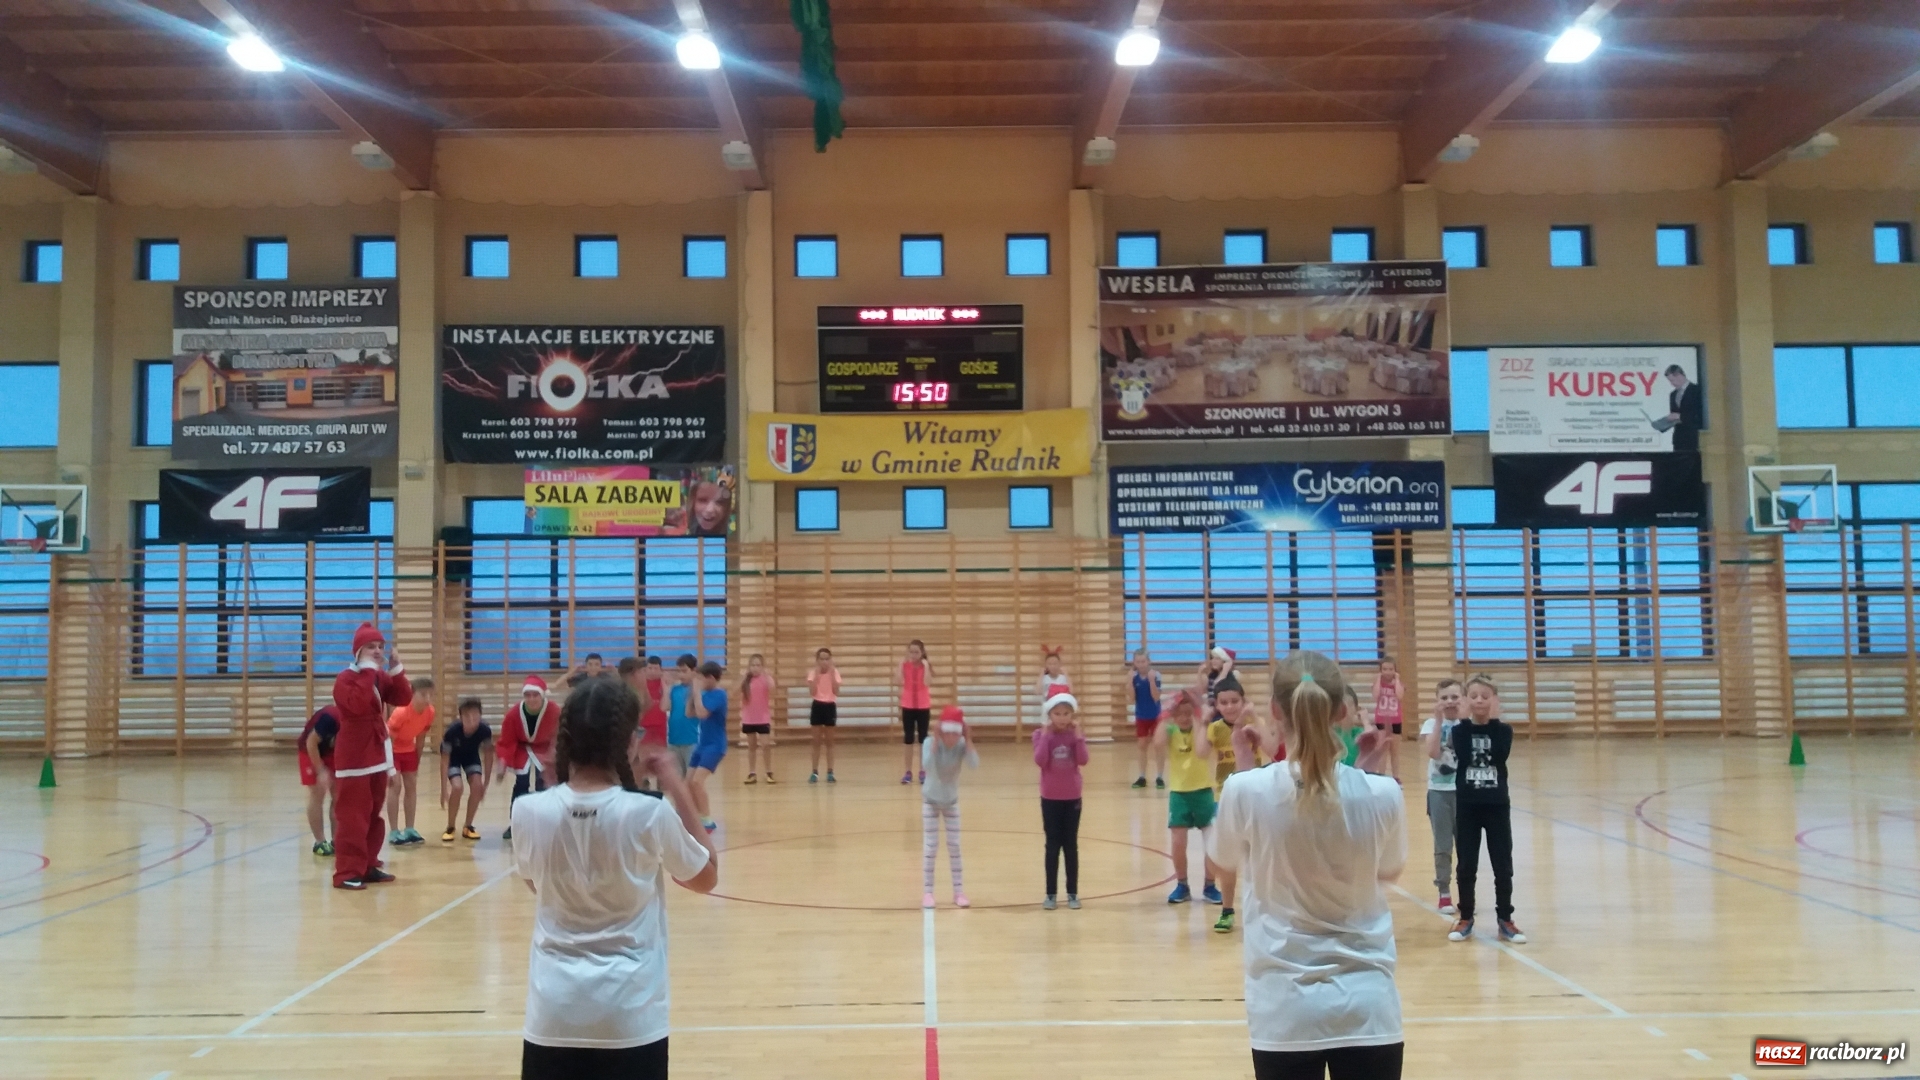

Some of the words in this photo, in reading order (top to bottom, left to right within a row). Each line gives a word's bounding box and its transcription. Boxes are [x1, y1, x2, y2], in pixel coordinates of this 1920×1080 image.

[1382, 268, 1432, 277] CATERING
[1107, 275, 1196, 294] WESELA
[1204, 284, 1264, 292] SPOTKANIA
[1404, 278, 1442, 287] OGRÓD
[183, 290, 286, 309] SPONSOR
[291, 288, 387, 307] IMPREZY
[208, 315, 240, 325] Janik
[243, 315, 288, 326] Marcin,
[290, 313, 362, 326] Błażejowice
[892, 307, 947, 321] RUDNIK
[453, 329, 572, 344] INSTALACJE
[579, 329, 715, 344] ELEKTRYCZNE
[827, 362, 899, 376] GOSPODARZE
[959, 358, 998, 375] GOŚCIE
[1500, 358, 1534, 372] ZDZ
[507, 357, 671, 411] FIOŁKA
[1548, 371, 1659, 397] KURSY
[893, 383, 949, 402] 15:50
[1204, 407, 1286, 421] SZONOWICE
[1309, 406, 1329, 418] UL.
[1333, 405, 1389, 417] WYGON
[1393, 404, 1402, 416] 3
[510, 418, 531, 426] 603
[557, 418, 577, 426] 977
[639, 418, 660, 426] 603
[662, 418, 683, 426] 798
[686, 417, 706, 426] 967
[1250, 425, 1265, 434] tel.
[1288, 424, 1300, 433] 32
[1338, 423, 1350, 432] 30
[1367, 422, 1384, 431] +48
[258, 425, 313, 437] MERCEDES,
[316, 424, 347, 435] GRUPA
[371, 423, 388, 434] VW
[510, 430, 531, 439] 605
[533, 430, 554, 439] 083
[640, 430, 661, 439] 607
[664, 430, 684, 439] 336
[903, 420, 1002, 447] Witamy
[222, 441, 247, 455] tel.
[250, 442, 270, 454] 77
[272, 441, 300, 454] 487
[304, 441, 322, 454] 57
[326, 440, 346, 453] 63
[515, 446, 654, 461] www.fiolka.com.pl
[840, 458, 862, 474] w
[871, 450, 962, 474] Gminie
[970, 446, 1061, 473] Rudnik
[1117, 473, 1152, 483] USŁUGI
[1155, 471, 1234, 482] INFORMATYCZNE
[535, 485, 588, 504] SALA
[596, 485, 674, 504] ZABAW
[1117, 486, 1209, 498] OPROGRAMOWANIE
[1212, 486, 1230, 496] DLA
[1234, 485, 1258, 496] FIRM
[1544, 461, 1653, 515] 4F
[210, 475, 321, 529] 4F
[1118, 502, 1161, 513] SYSTEMY
[1165, 499, 1264, 511] TELEINFORMATYCZNE
[1118, 516, 1179, 527] MONITORING
[1183, 515, 1225, 526] WIZYJNY
